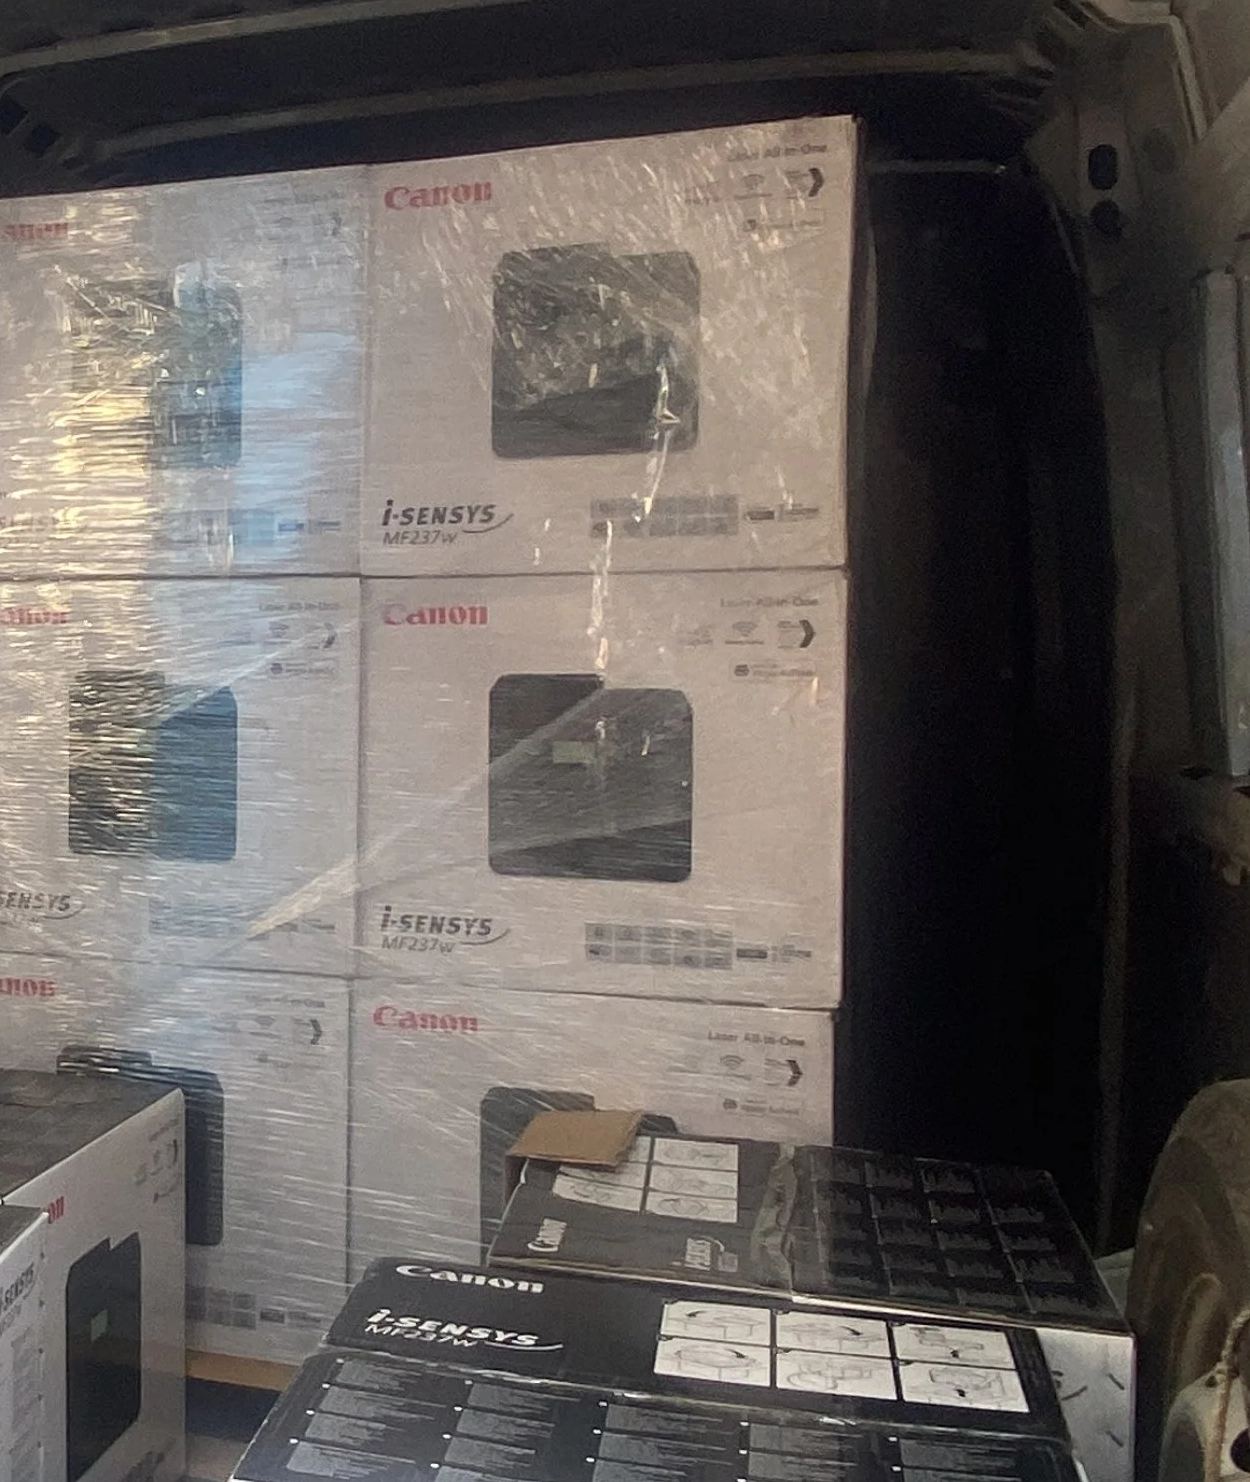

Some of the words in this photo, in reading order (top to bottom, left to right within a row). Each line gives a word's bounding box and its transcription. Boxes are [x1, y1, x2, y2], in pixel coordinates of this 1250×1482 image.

[384, 180, 493, 213] Canon
[381, 498, 496, 527] i-SENSYS
[383, 529, 458, 547] MF237w
[383, 603, 489, 626] Canon
[380, 905, 493, 937] i-SENSYS
[381, 935, 457, 954] MF237w
[372, 1005, 479, 1033] Canon
[395, 1265, 545, 1295] Canon
[365, 1323, 479, 1349] MF237w
[366, 1308, 541, 1347] i-SENSYS
